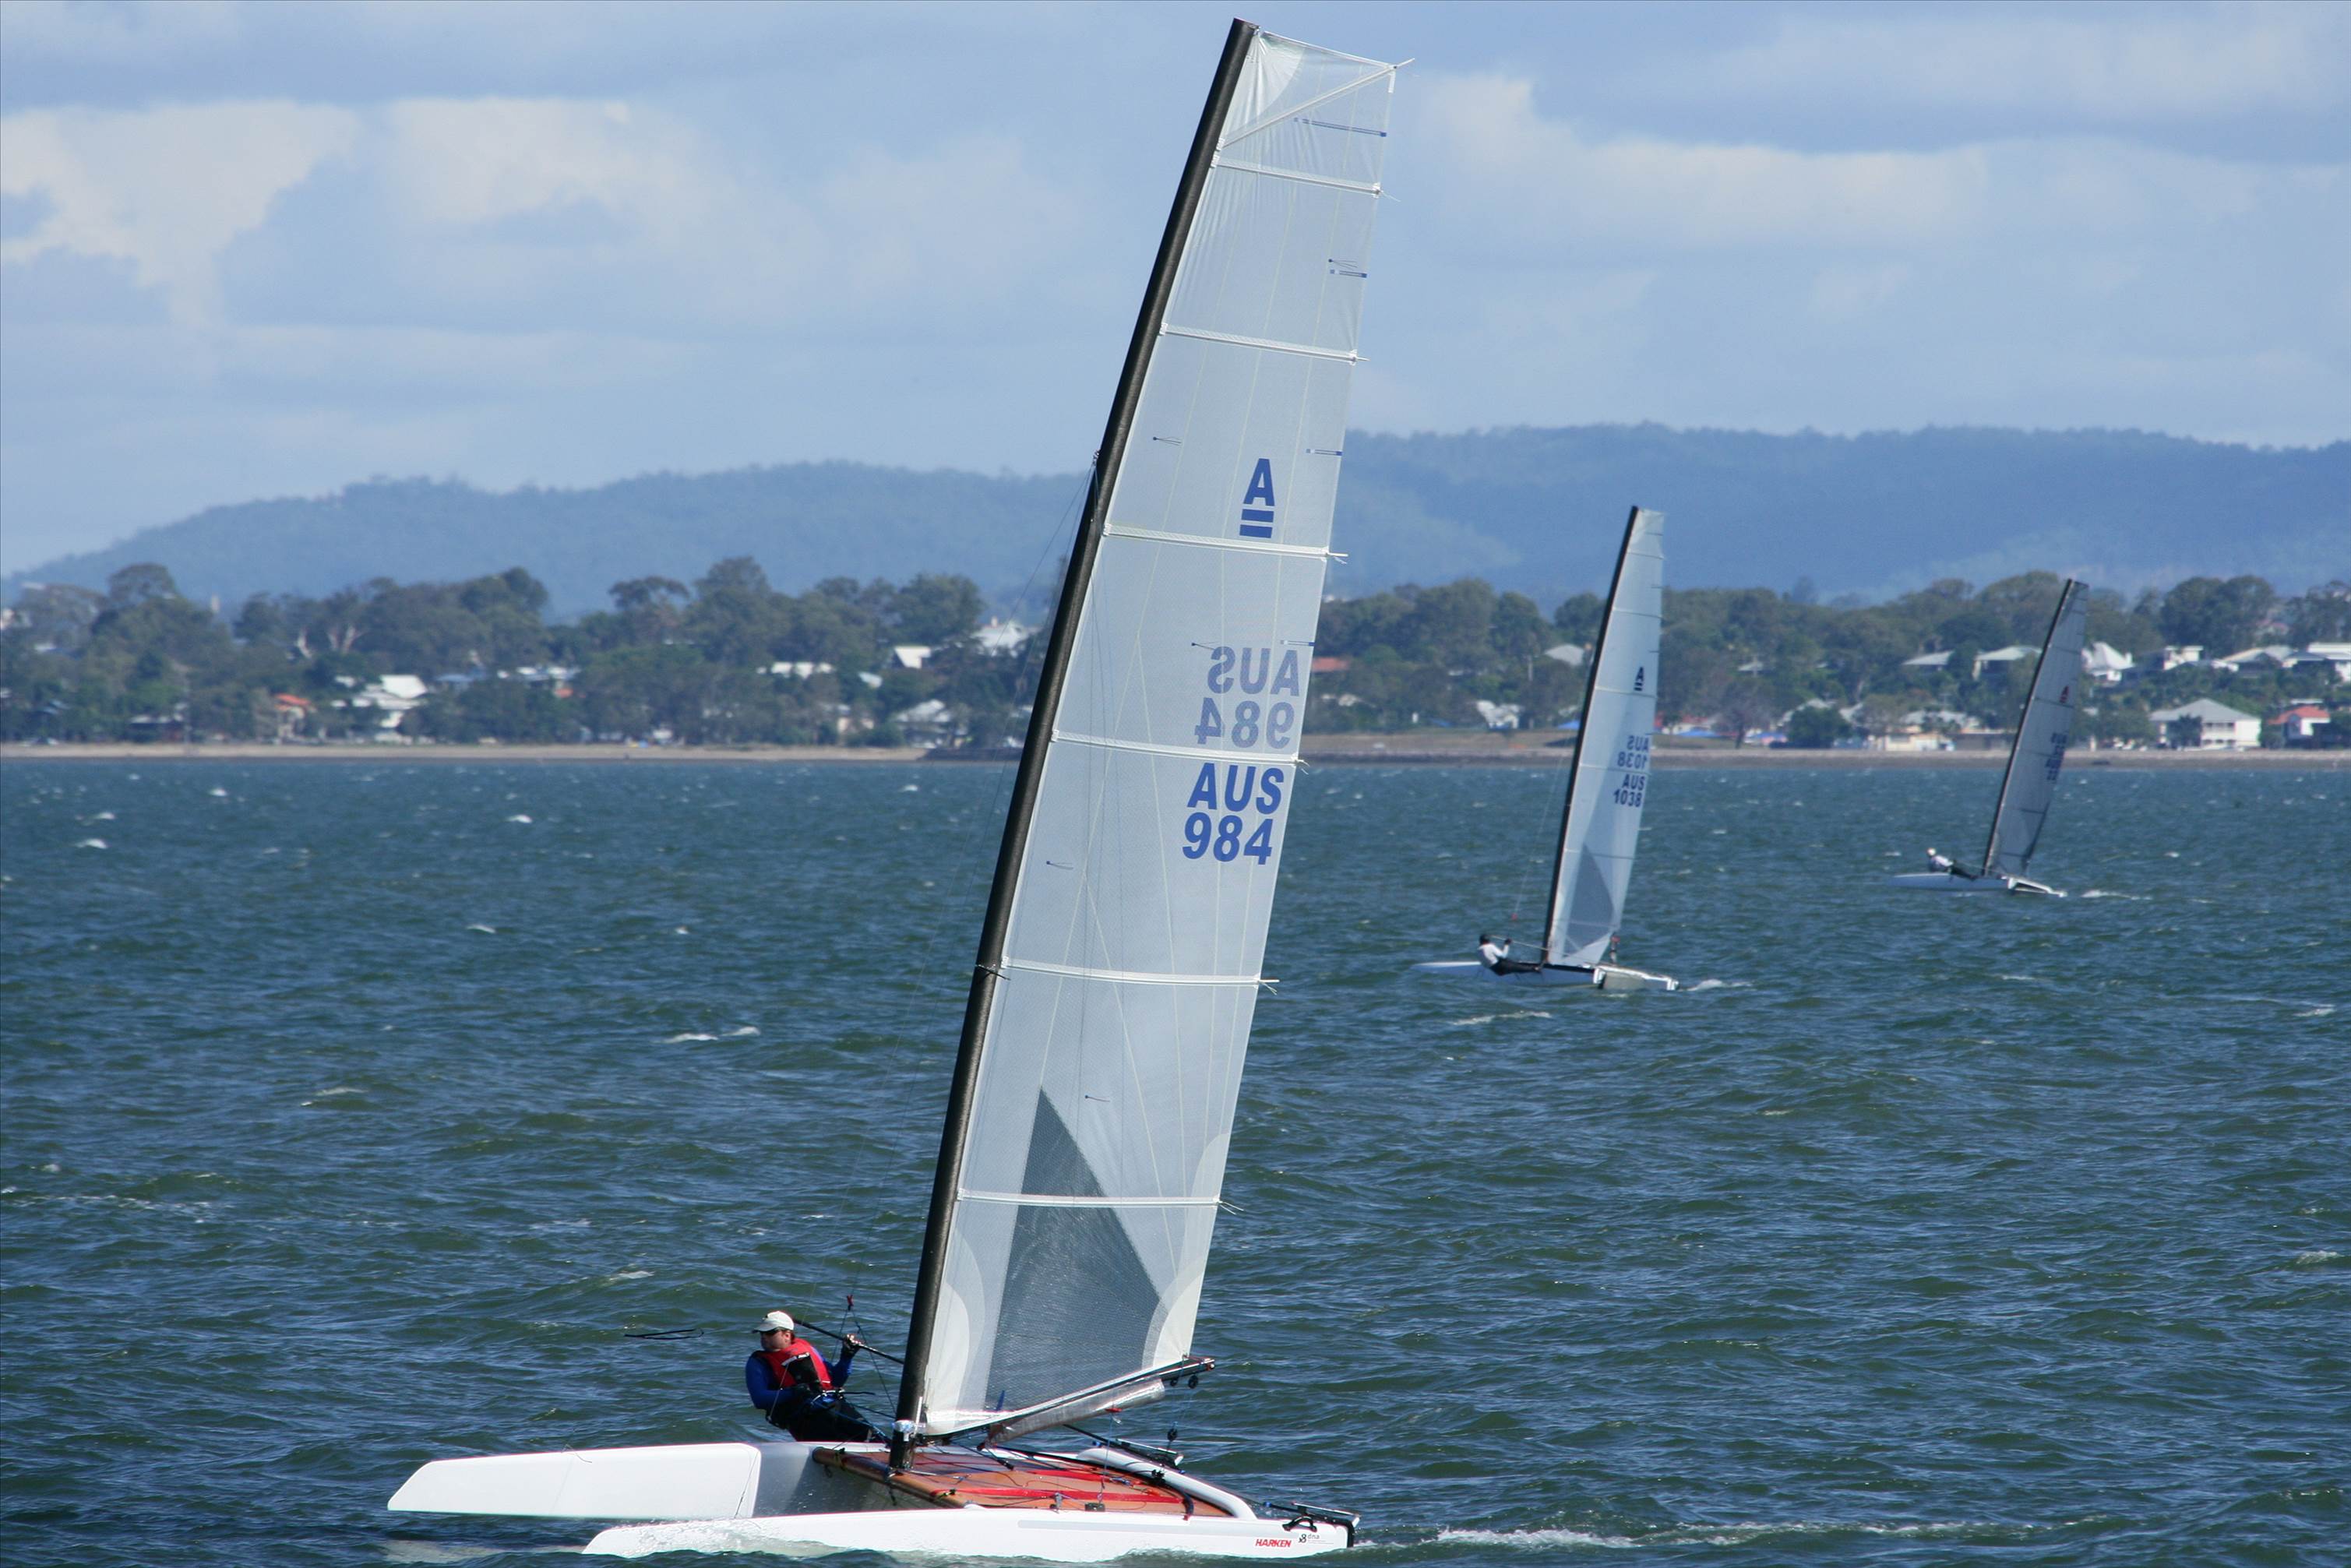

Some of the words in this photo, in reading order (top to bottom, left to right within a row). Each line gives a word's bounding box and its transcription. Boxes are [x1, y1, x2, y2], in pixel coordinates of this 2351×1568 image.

[1244, 458, 1275, 507] A
[1636, 666, 1644, 682] A
[1187, 762, 1285, 815] AUS
[1621, 773, 1646, 791] AUS
[1613, 789, 1643, 808] 1038
[1183, 812, 1273, 865] 984
[1255, 1538, 1292, 1548] HARKEN
